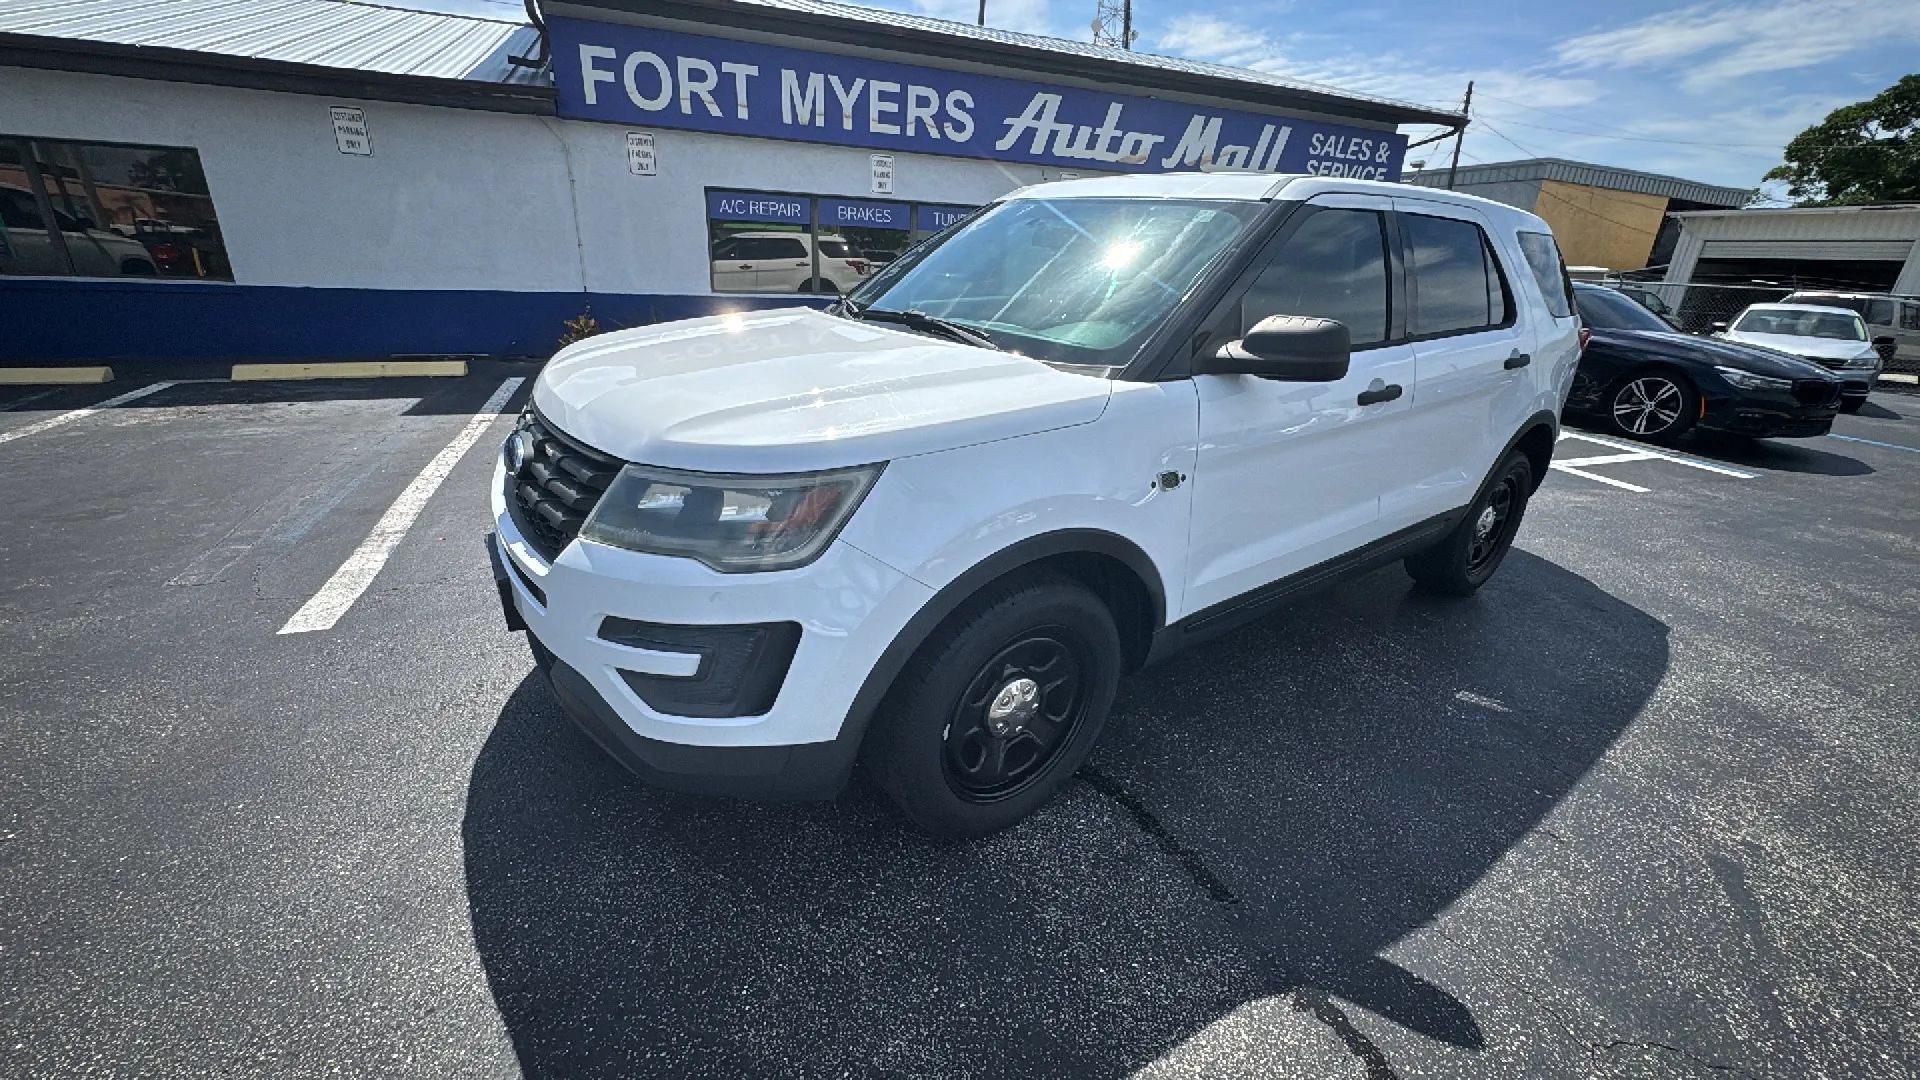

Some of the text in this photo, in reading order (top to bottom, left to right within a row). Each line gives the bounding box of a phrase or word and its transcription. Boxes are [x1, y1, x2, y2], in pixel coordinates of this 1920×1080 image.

[578, 43, 1293, 174] FORT MYERS Auto Mall
[1309, 132, 1391, 163] SALES &
[1306, 159, 1389, 181] SERVICE
[719, 199, 801, 217] A/C REPAIR
[837, 205, 892, 223] BRAKES
